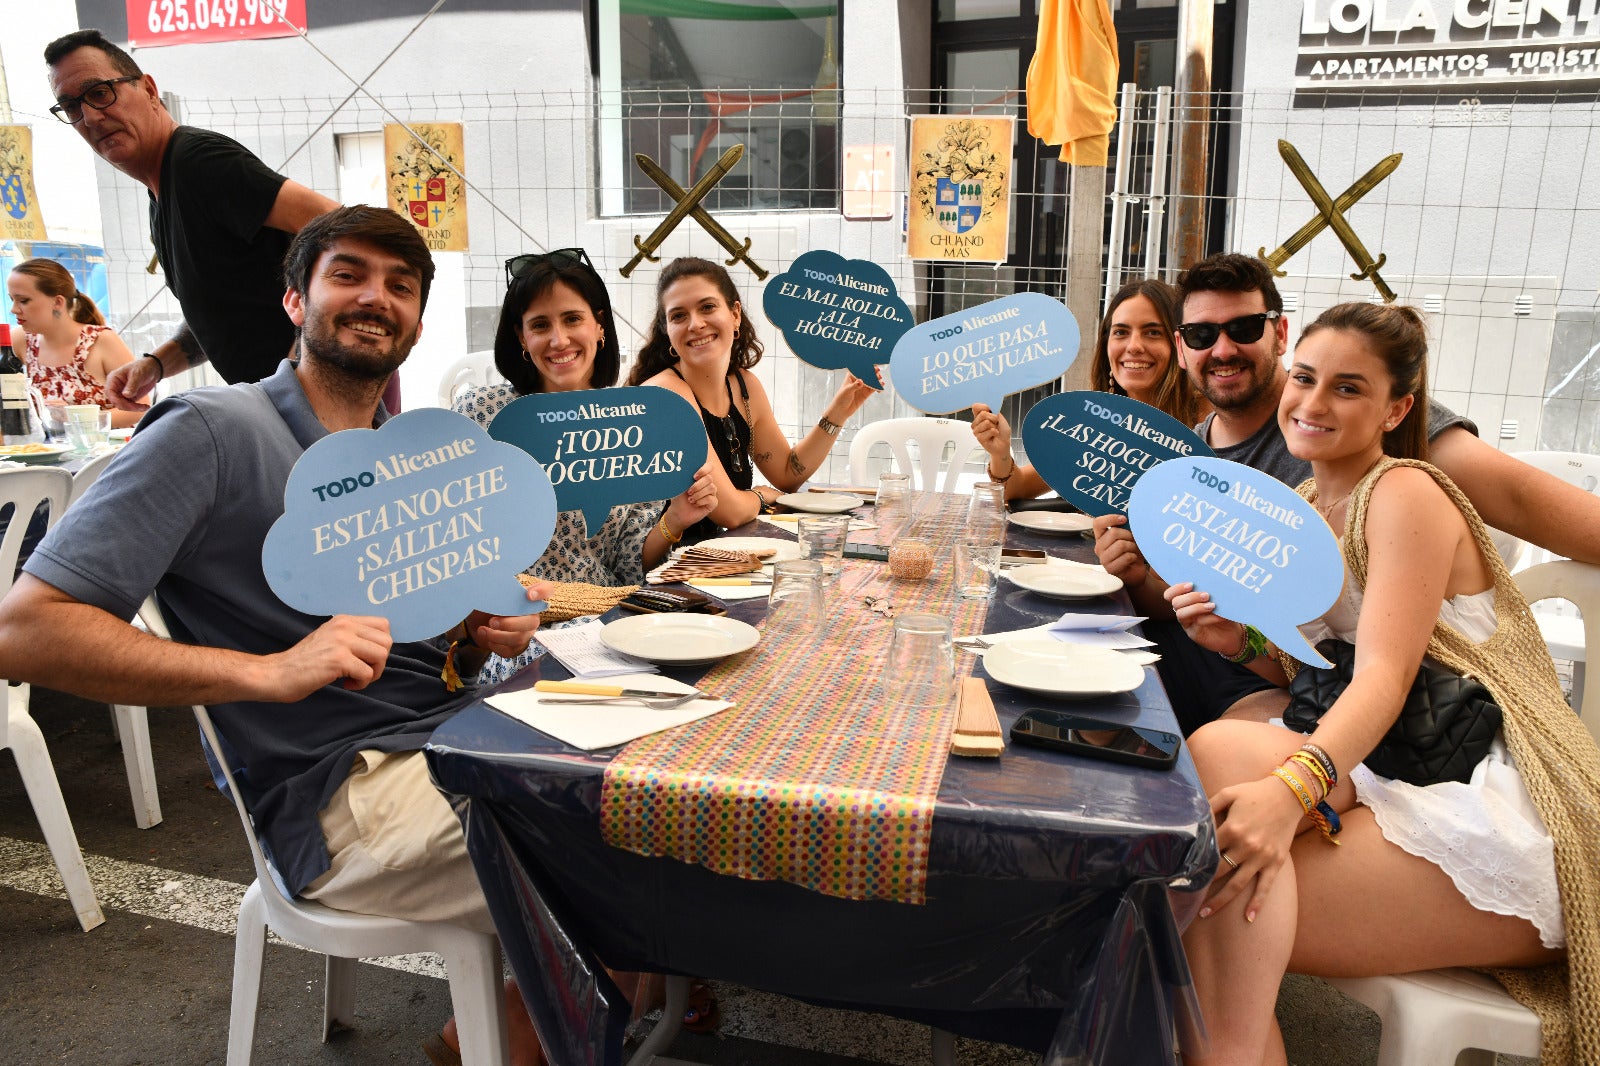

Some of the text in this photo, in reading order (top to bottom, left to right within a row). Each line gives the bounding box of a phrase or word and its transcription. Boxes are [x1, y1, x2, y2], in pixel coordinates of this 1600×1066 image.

[1301, 0, 1439, 34] LOLA
[1310, 54, 1489, 76] APARTAMENTOS
[930, 234, 984, 247] CHUANO
[943, 247, 971, 258] MAS
[778, 282, 904, 323] EL MAL ROLLO...
[804, 269, 889, 296] TODOAlicante
[794, 320, 882, 350] HOGUERA!
[836, 312, 861, 328] LA
[929, 307, 1020, 341] TODOAlicante
[920, 339, 1063, 395] EN SAN JUAN...
[922, 319, 1049, 374] LO QUE PASA
[537, 403, 647, 424] TODOAlicante
[1083, 399, 1193, 457] TODOAlicante
[555, 425, 643, 461] ¡TODO
[1040, 413, 1164, 472] ¡LAS HOGU
[312, 438, 477, 502] TODOAlicante
[1075, 451, 1137, 490] SON L
[311, 465, 508, 555] ESTA NOCHE
[1191, 466, 1305, 530] TODOAlicante
[357, 506, 484, 582] ¡SALTAN
[1161, 491, 1298, 569] ¡ESTAMOS
[367, 536, 501, 605] CHISPAS!
[1162, 522, 1274, 594] ON FIRE!
